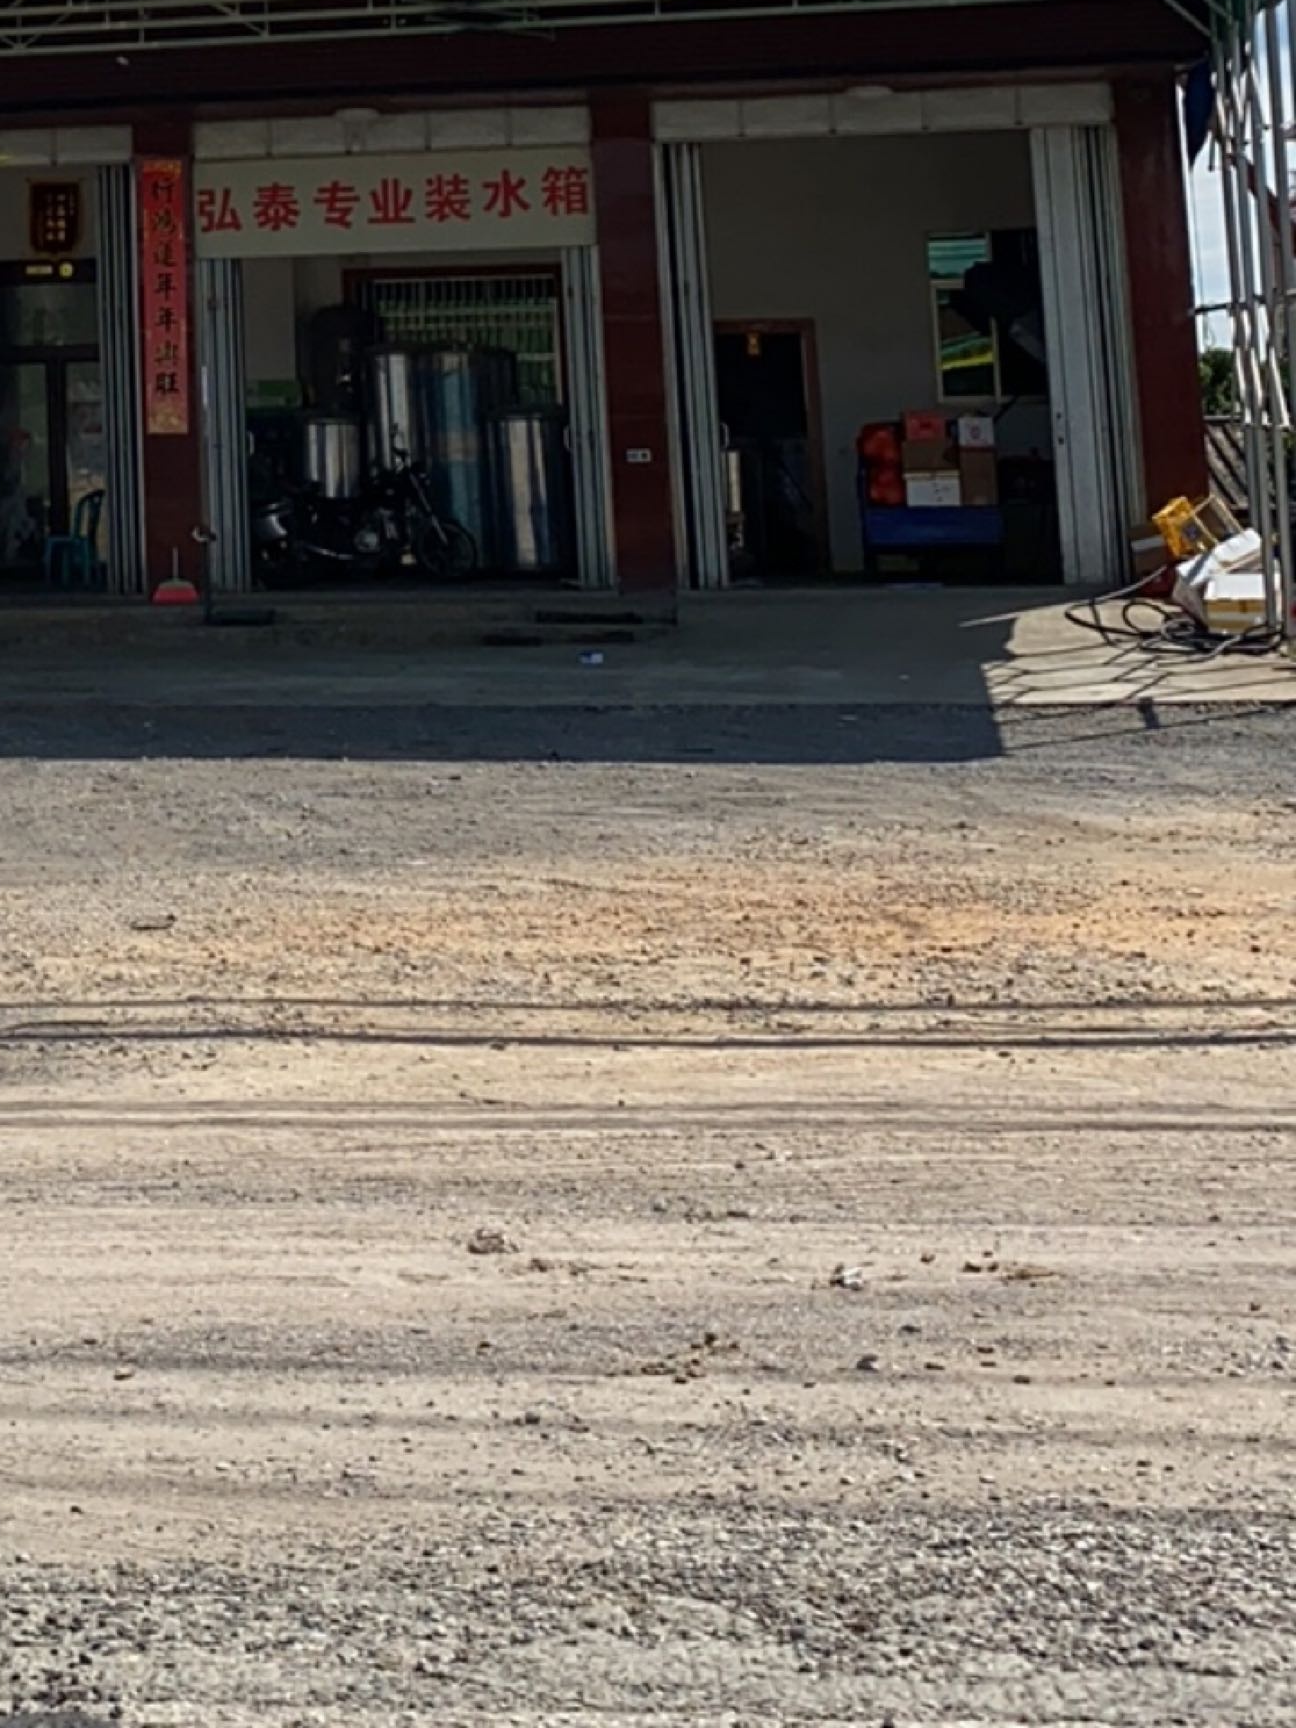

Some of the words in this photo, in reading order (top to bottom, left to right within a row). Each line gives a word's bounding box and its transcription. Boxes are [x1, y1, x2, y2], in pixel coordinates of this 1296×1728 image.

[197, 166, 591, 233] 弘泰专业装水箱
